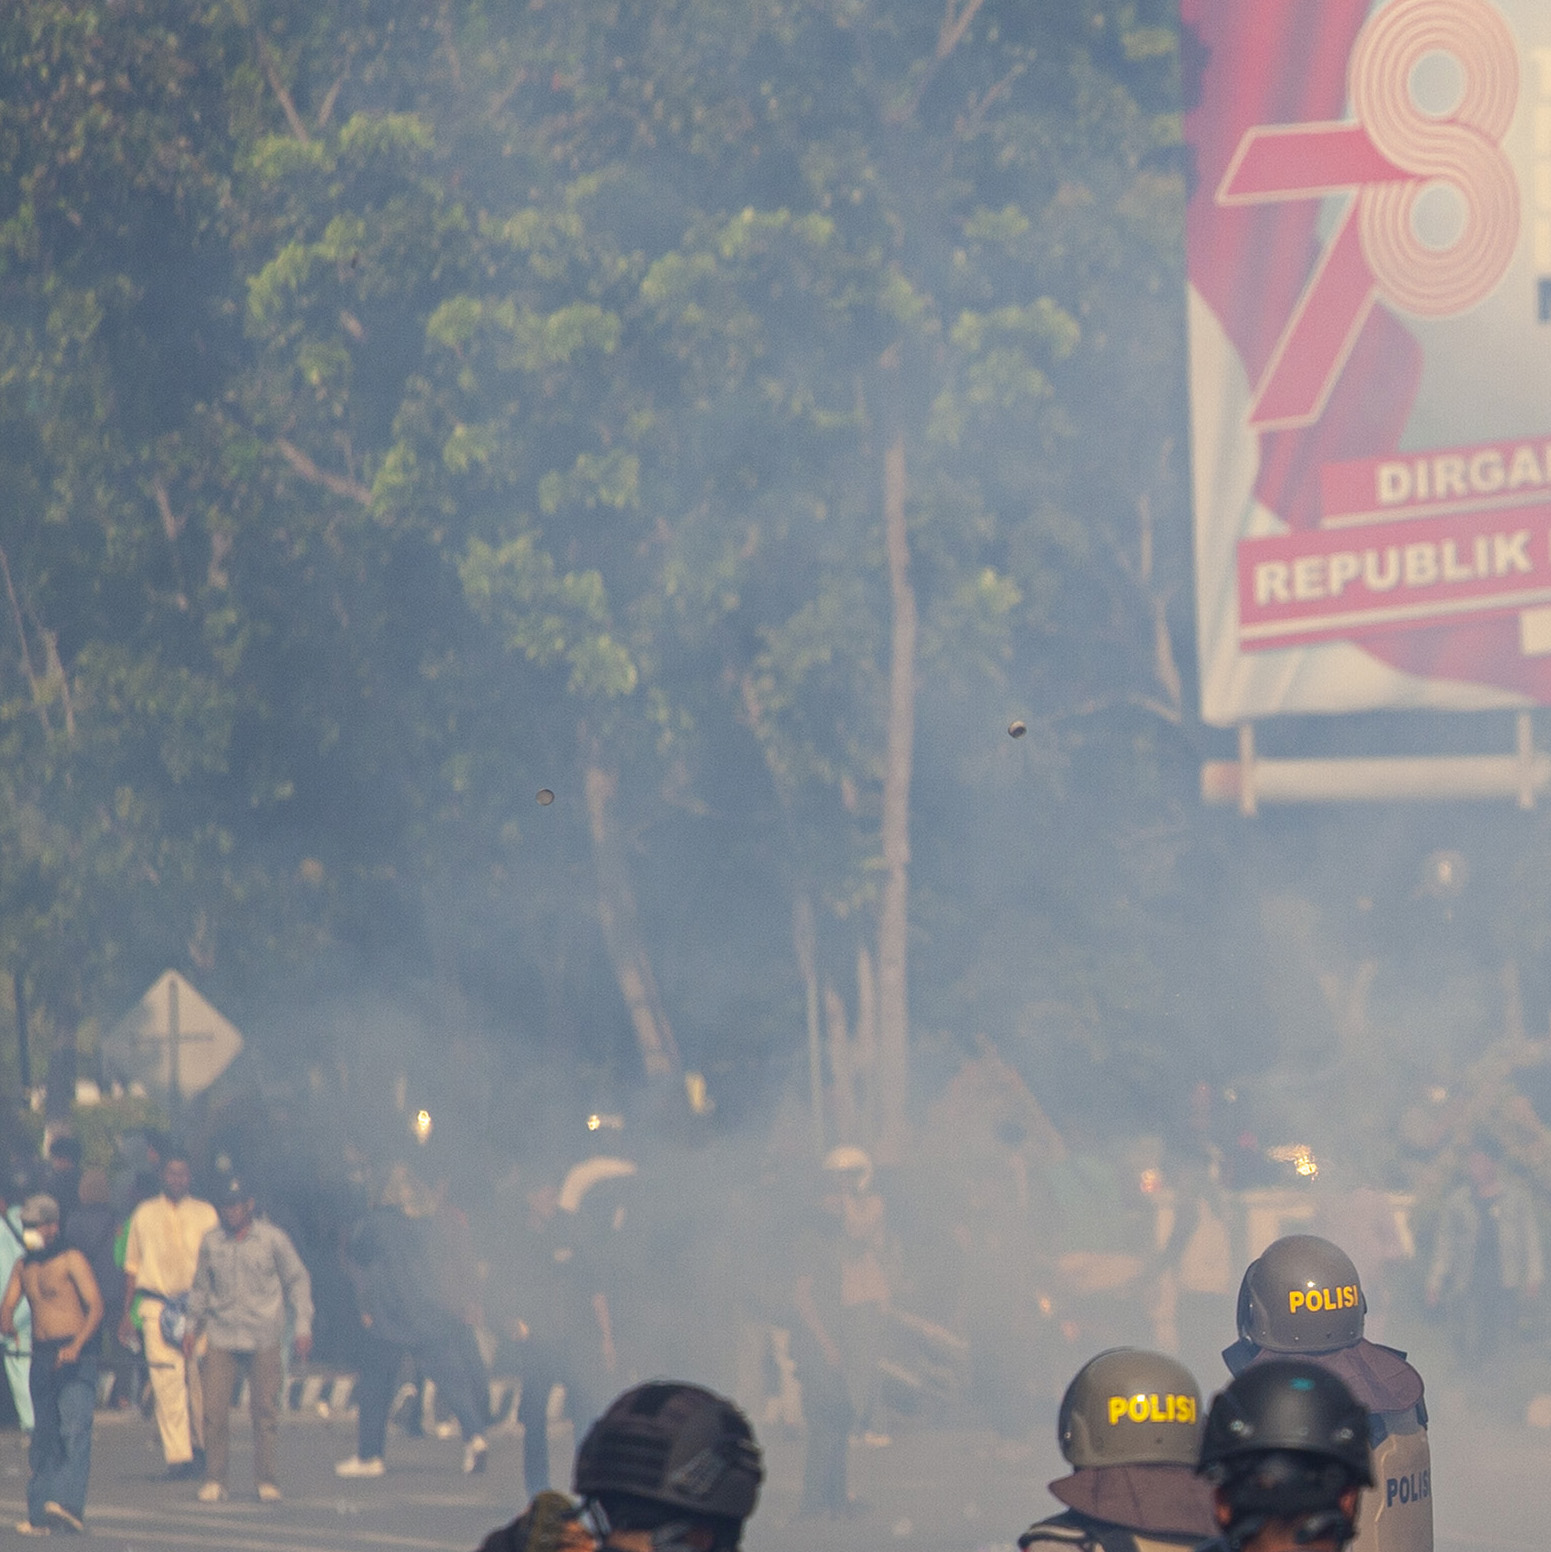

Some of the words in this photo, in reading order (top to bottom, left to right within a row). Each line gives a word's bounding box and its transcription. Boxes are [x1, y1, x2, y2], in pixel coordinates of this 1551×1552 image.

[1253, 530, 1532, 605] REPUBLIK
[1288, 1284, 1359, 1313] POLISI
[1108, 1393, 1197, 1425] POLISI
[1386, 1467, 1431, 1507] POLIS
